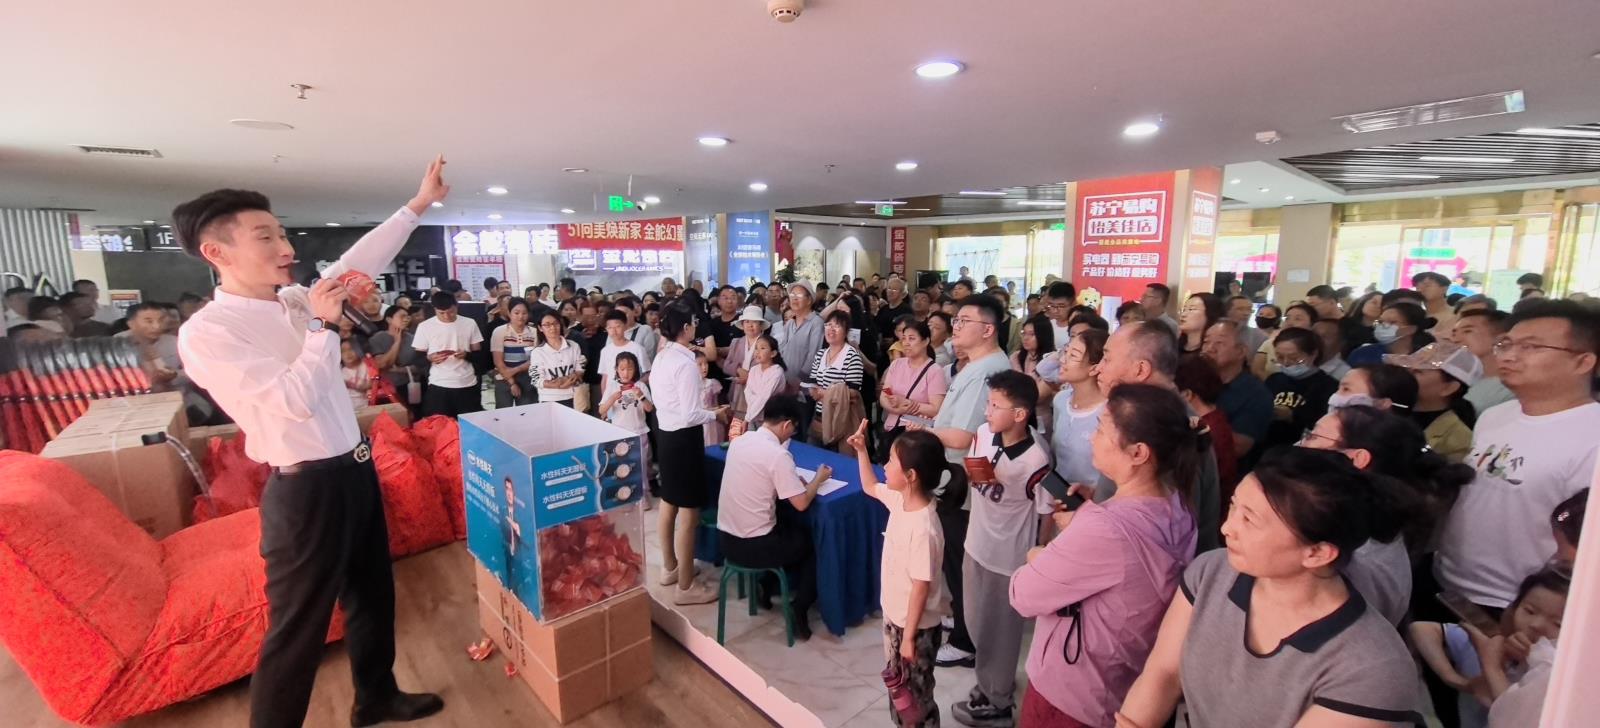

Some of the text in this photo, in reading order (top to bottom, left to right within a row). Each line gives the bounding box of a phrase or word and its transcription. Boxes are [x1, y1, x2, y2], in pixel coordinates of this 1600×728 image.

[1090, 198, 1158, 216] 苏宁易购
[1091, 219, 1153, 234] 怡美佳店
